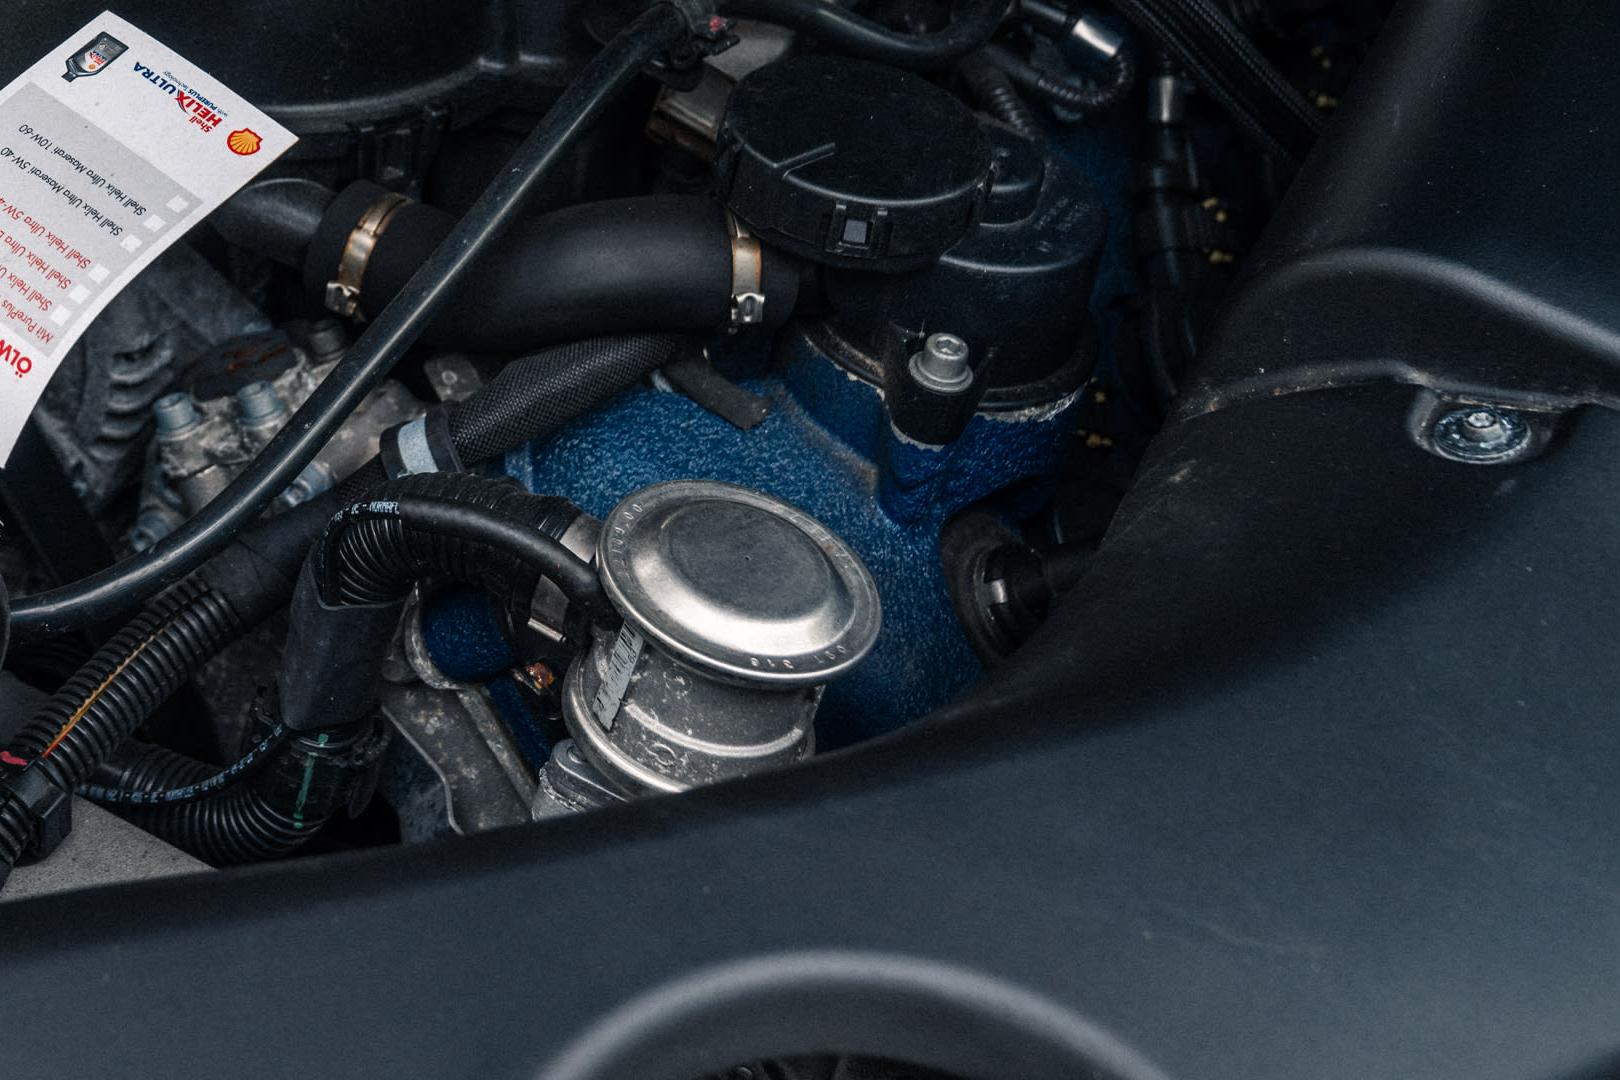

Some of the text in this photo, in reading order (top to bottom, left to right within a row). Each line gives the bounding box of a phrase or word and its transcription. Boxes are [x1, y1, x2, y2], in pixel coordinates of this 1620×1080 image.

[133, 61, 223, 127] HELIX ULTRA
[162, 71, 229, 117] with PUREPLUS Technology
[189, 116, 213, 133] Shell
[18, 124, 147, 216] Shell Helix Ultra Maserati 10W-60
[0, 146, 123, 236] Shell Helix Ultra Maserati 5W-40
[23, 216, 46, 237] Ultra
[4, 235, 26, 257] Ultra
[45, 232, 69, 254] Helix
[25, 251, 49, 274] Helix
[65, 248, 91, 270] Shell
[6, 272, 30, 296] Helix
[45, 268, 71, 290] Shell
[26, 289, 53, 312] Shell
[1, 299, 37, 333] PurePlus
[35, 326, 54, 344] Mit
